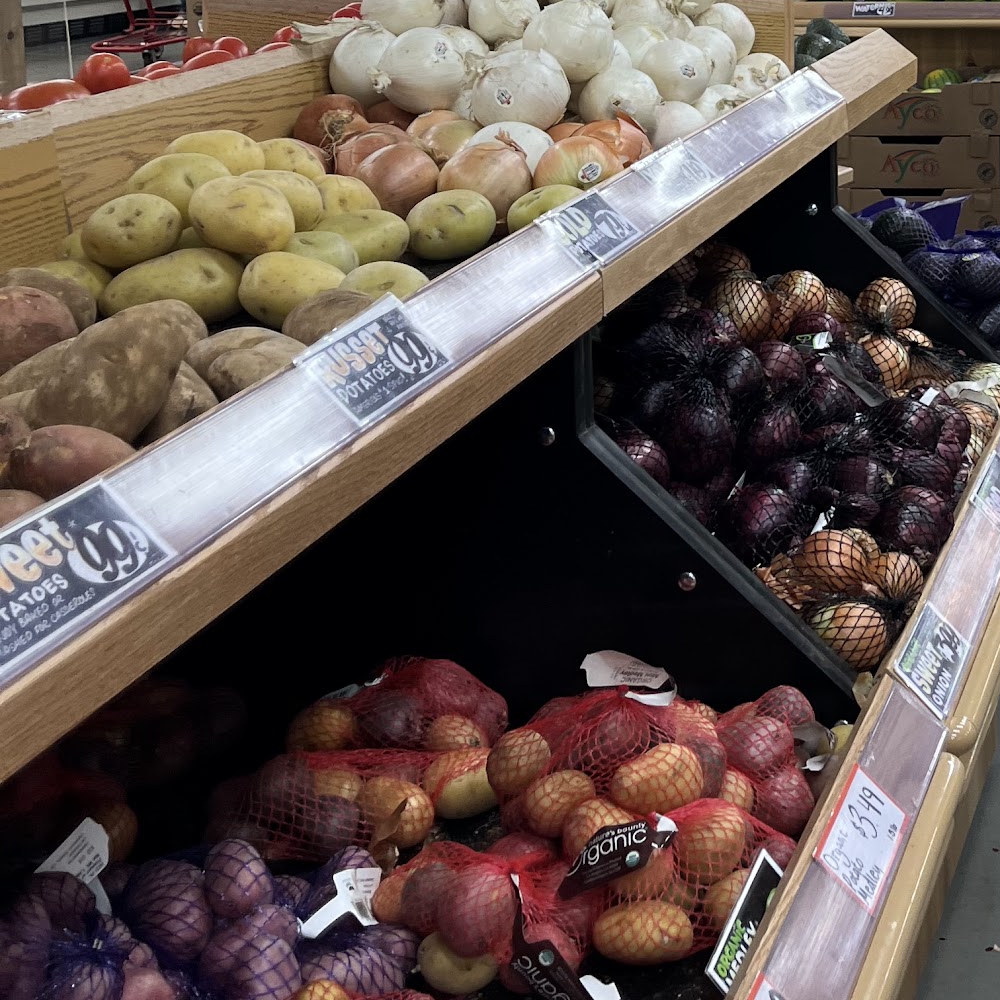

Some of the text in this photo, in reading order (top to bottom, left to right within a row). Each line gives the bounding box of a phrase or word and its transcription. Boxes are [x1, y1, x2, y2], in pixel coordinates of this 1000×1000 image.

[555, 207, 592, 246] OLD
[336, 359, 396, 404] POTATOES
[0, 517, 75, 593] eet
[0, 573, 69, 621] TATOES
[18, 603, 49, 628] BAKED
[35, 619, 51, 634] FOR
[617, 822, 647, 834] bounty
[842, 857, 863, 892] Potato
[858, 865, 885, 907] Medley
[716, 919, 745, 978] ORGANIC
[517, 955, 572, 1000] ganic
